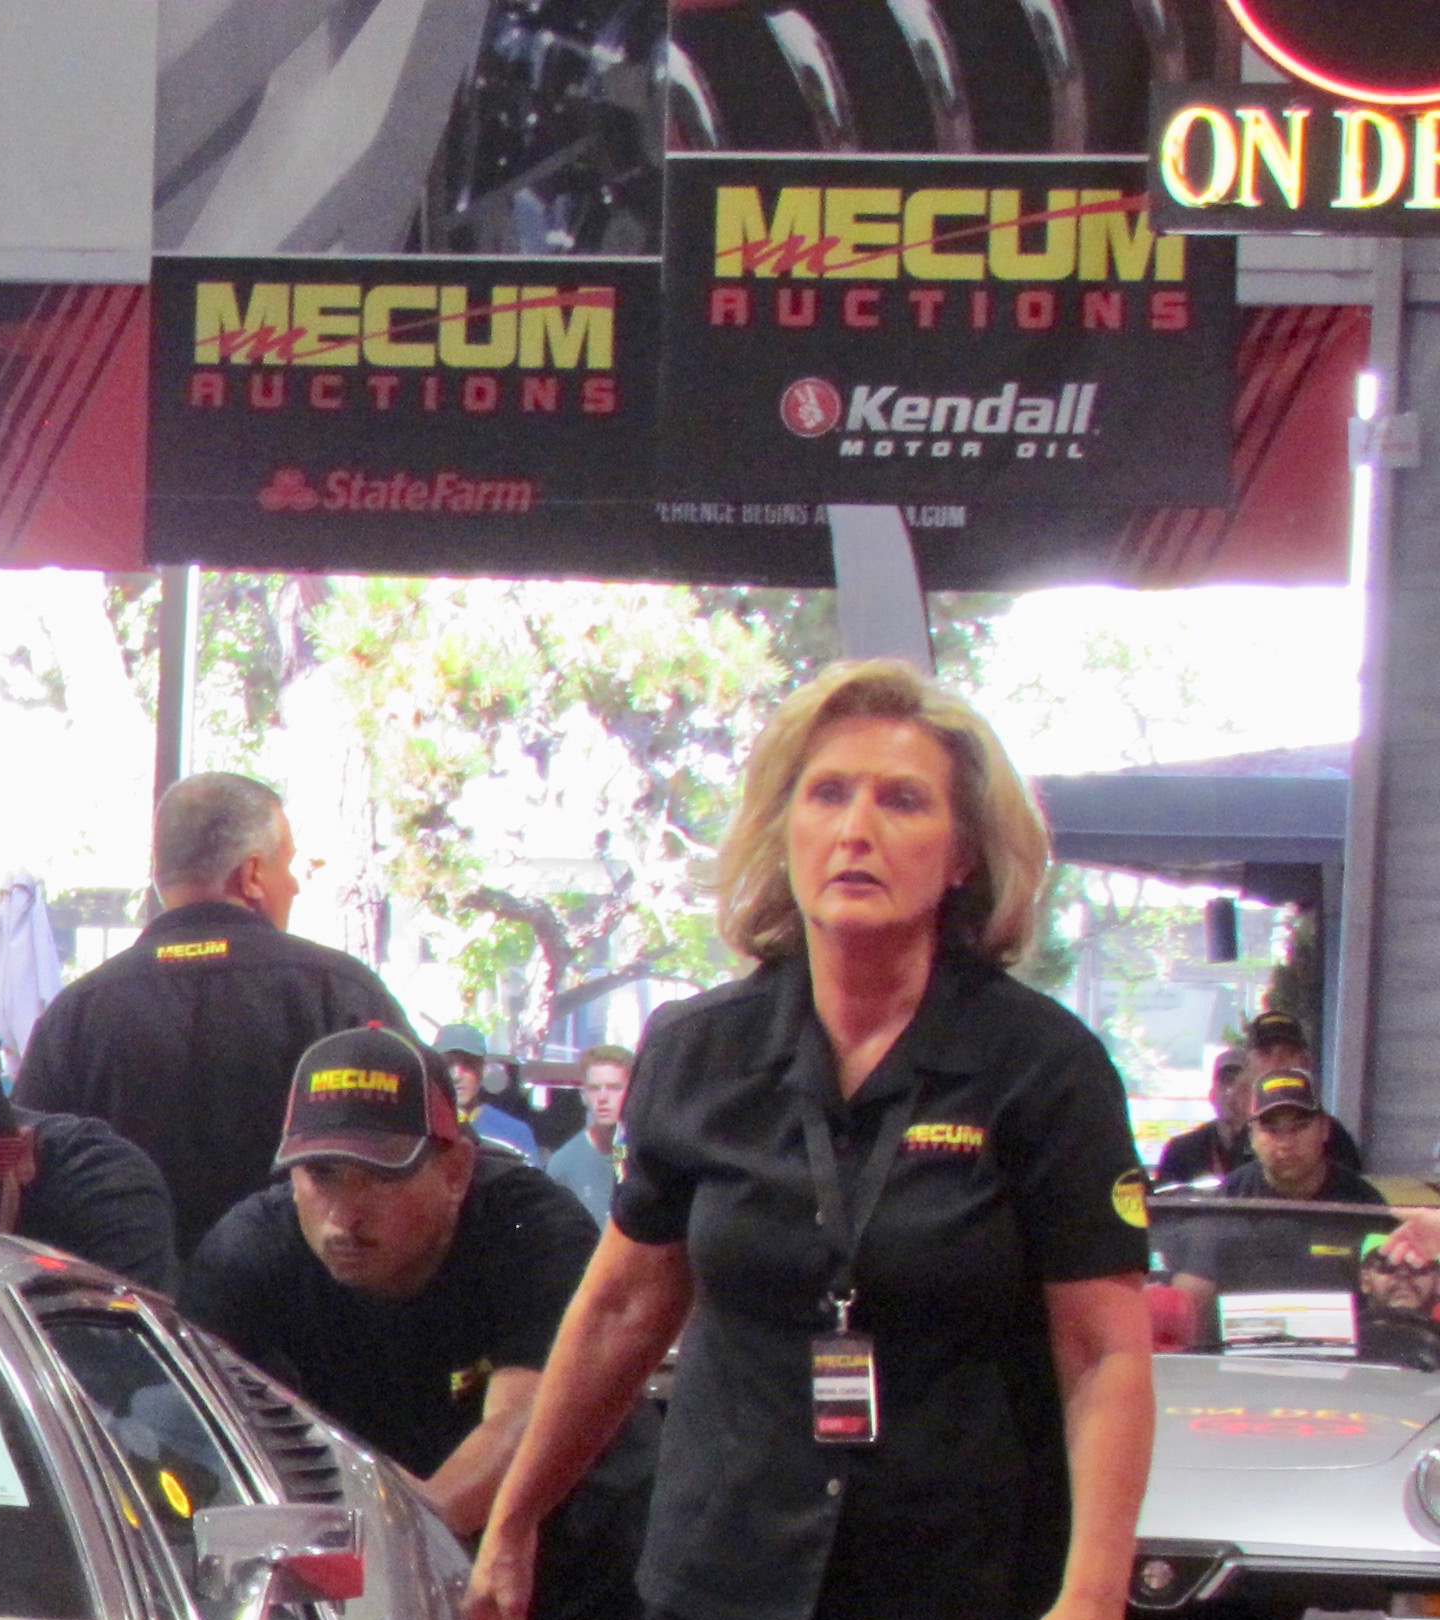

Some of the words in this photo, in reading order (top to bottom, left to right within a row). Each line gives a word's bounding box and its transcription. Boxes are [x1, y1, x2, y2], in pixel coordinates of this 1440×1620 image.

[1160, 105, 1312, 209] ON
[715, 186, 1186, 282] MECUM
[194, 282, 615, 369] MECUM
[710, 288, 1190, 330] AUCTIONS
[190, 371, 618, 413] AUCTIONS
[847, 383, 1096, 434] Kendall
[839, 438, 983, 458] MOTOR
[1017, 442, 1083, 460] OIL
[156, 939, 229, 959] MECUM
[310, 1068, 399, 1095] MECUM
